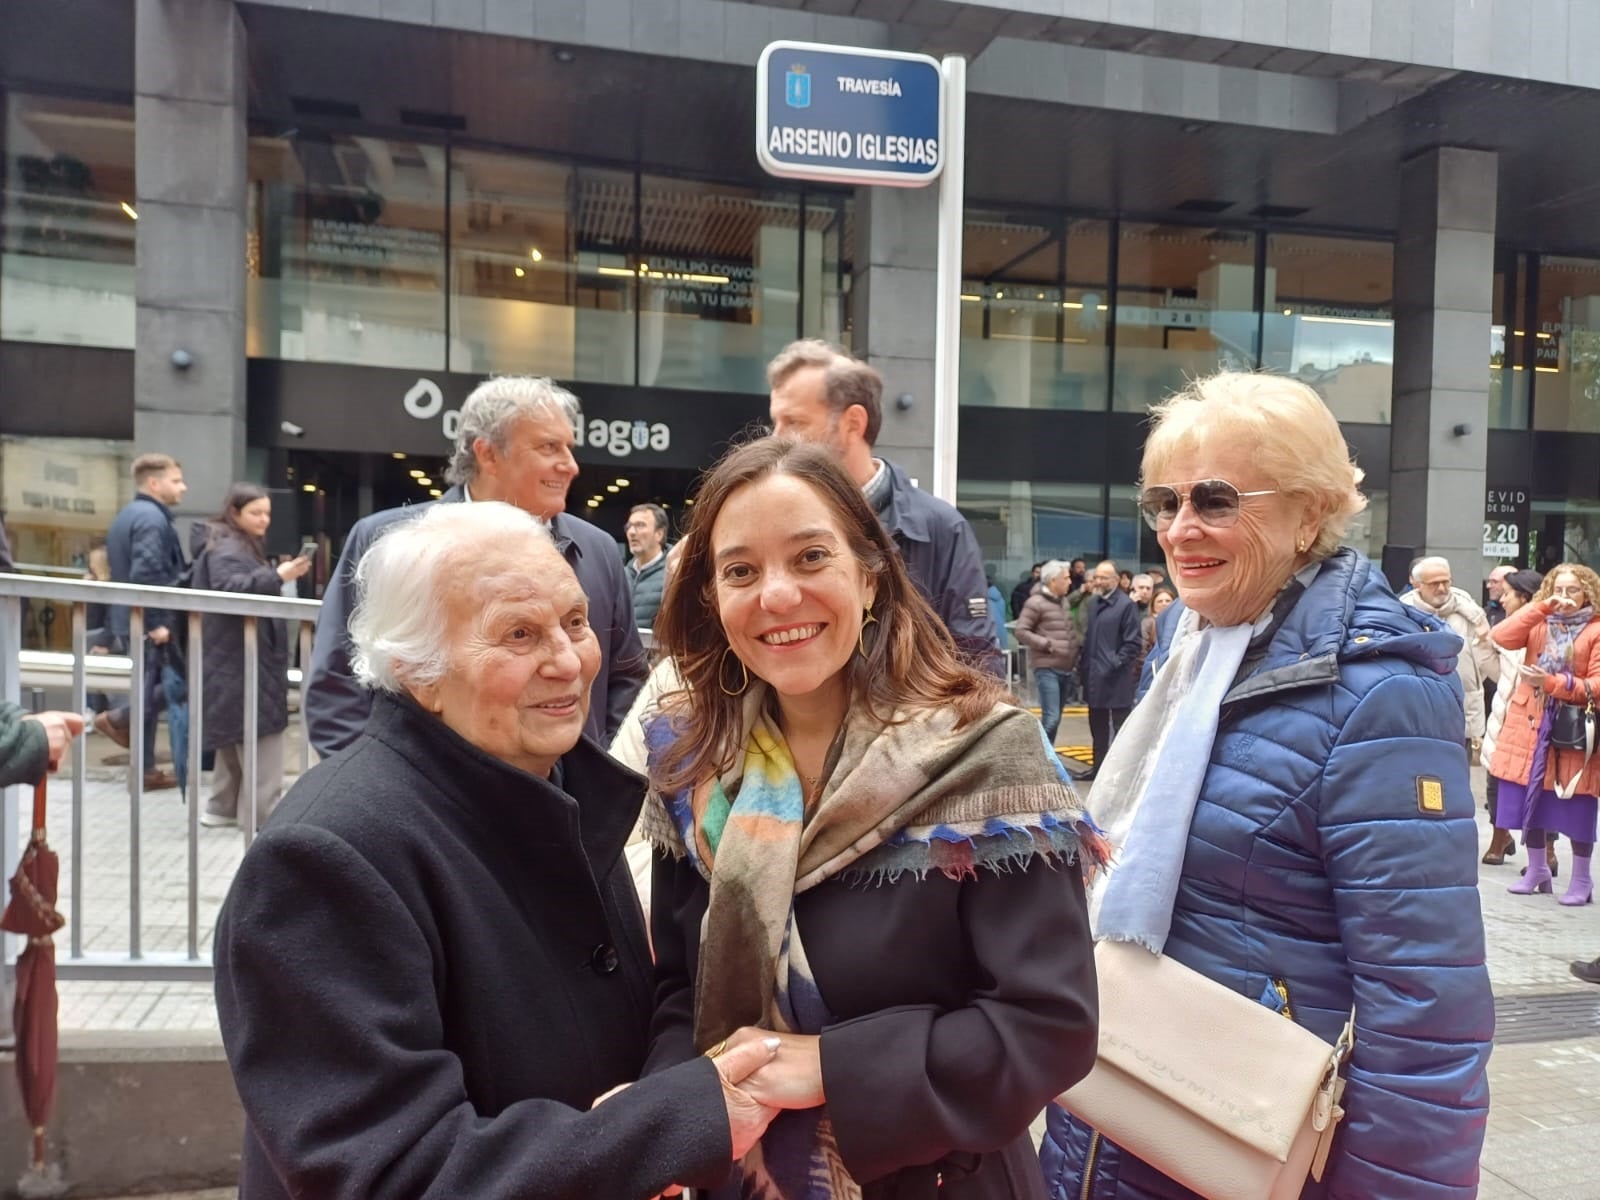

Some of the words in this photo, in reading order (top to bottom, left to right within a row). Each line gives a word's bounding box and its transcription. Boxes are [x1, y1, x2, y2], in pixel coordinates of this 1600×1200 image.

[837, 76, 902, 97] TRAVESÍA
[768, 126, 852, 159] ARSENIO
[856, 133, 938, 166] IGLESIAS
[1487, 490, 1526, 504] EVID
[1487, 503, 1498, 513] DE
